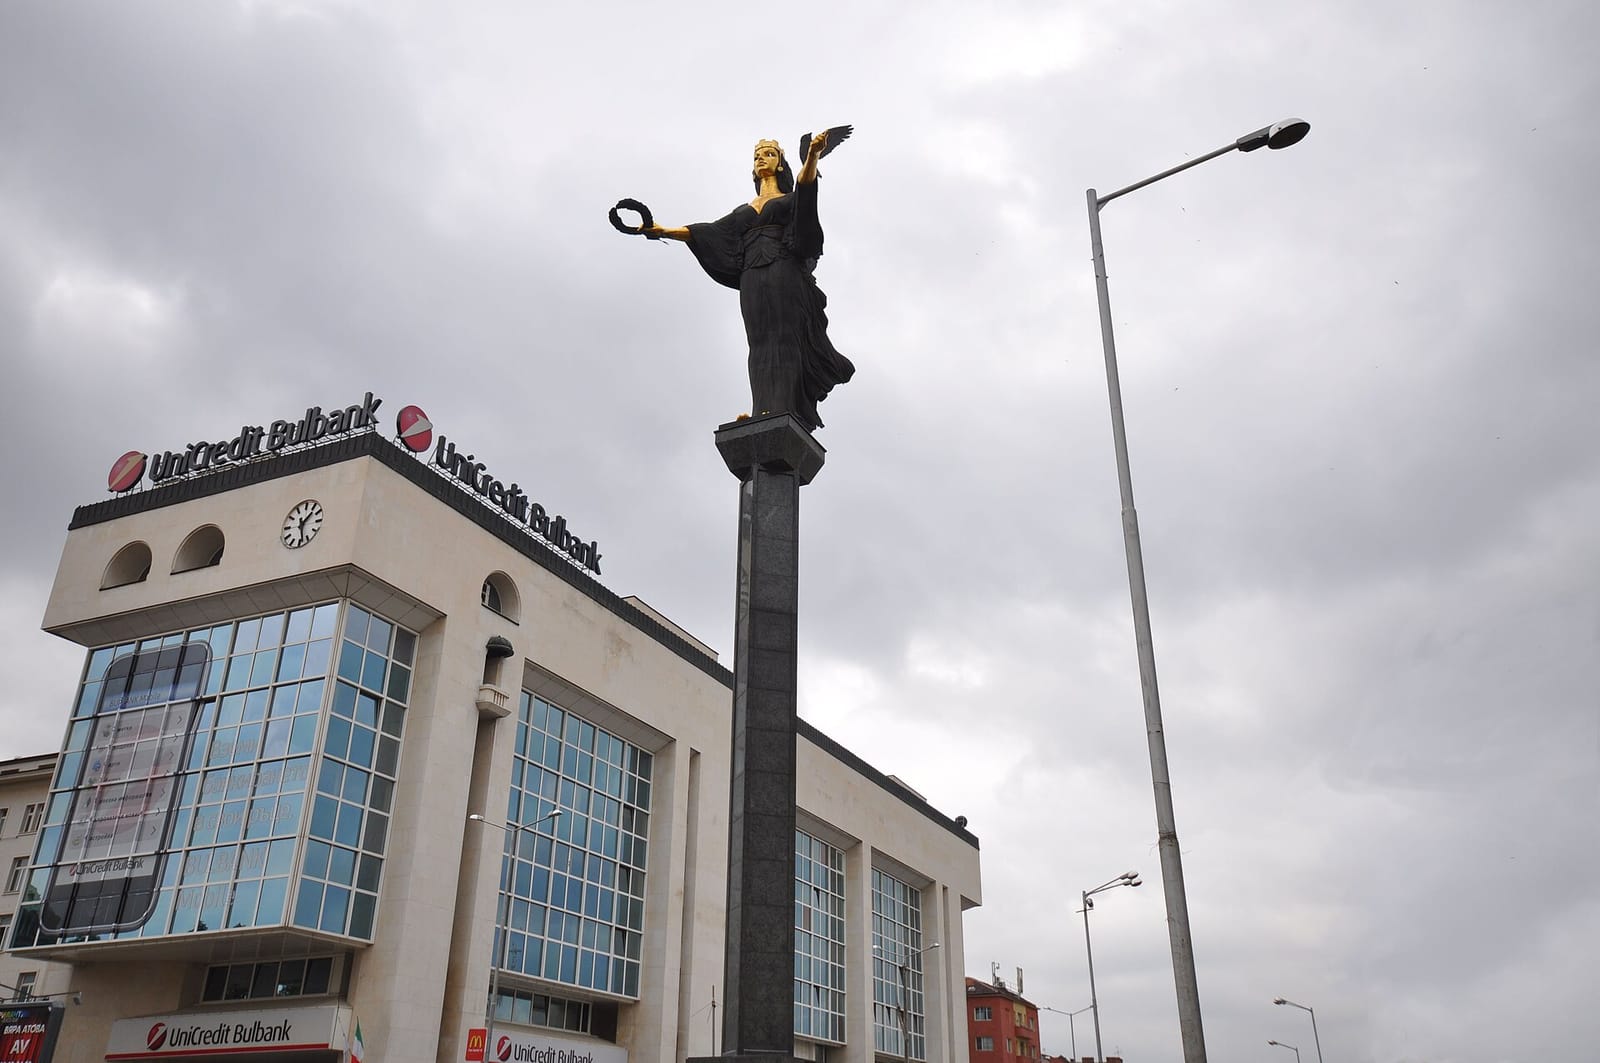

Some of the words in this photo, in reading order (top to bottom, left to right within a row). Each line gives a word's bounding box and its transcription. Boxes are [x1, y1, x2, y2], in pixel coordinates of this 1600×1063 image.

[149, 425, 265, 482] UniCredit
[266, 391, 383, 451] Bulbank
[435, 435, 530, 524] UniCredit
[530, 502, 602, 575] Bulbank
[169, 1022, 231, 1047] UniCredit
[233, 1018, 292, 1044] Bulbank
[514, 1043, 556, 1063] UniCredit
[558, 1049, 594, 1063] Bulbank
